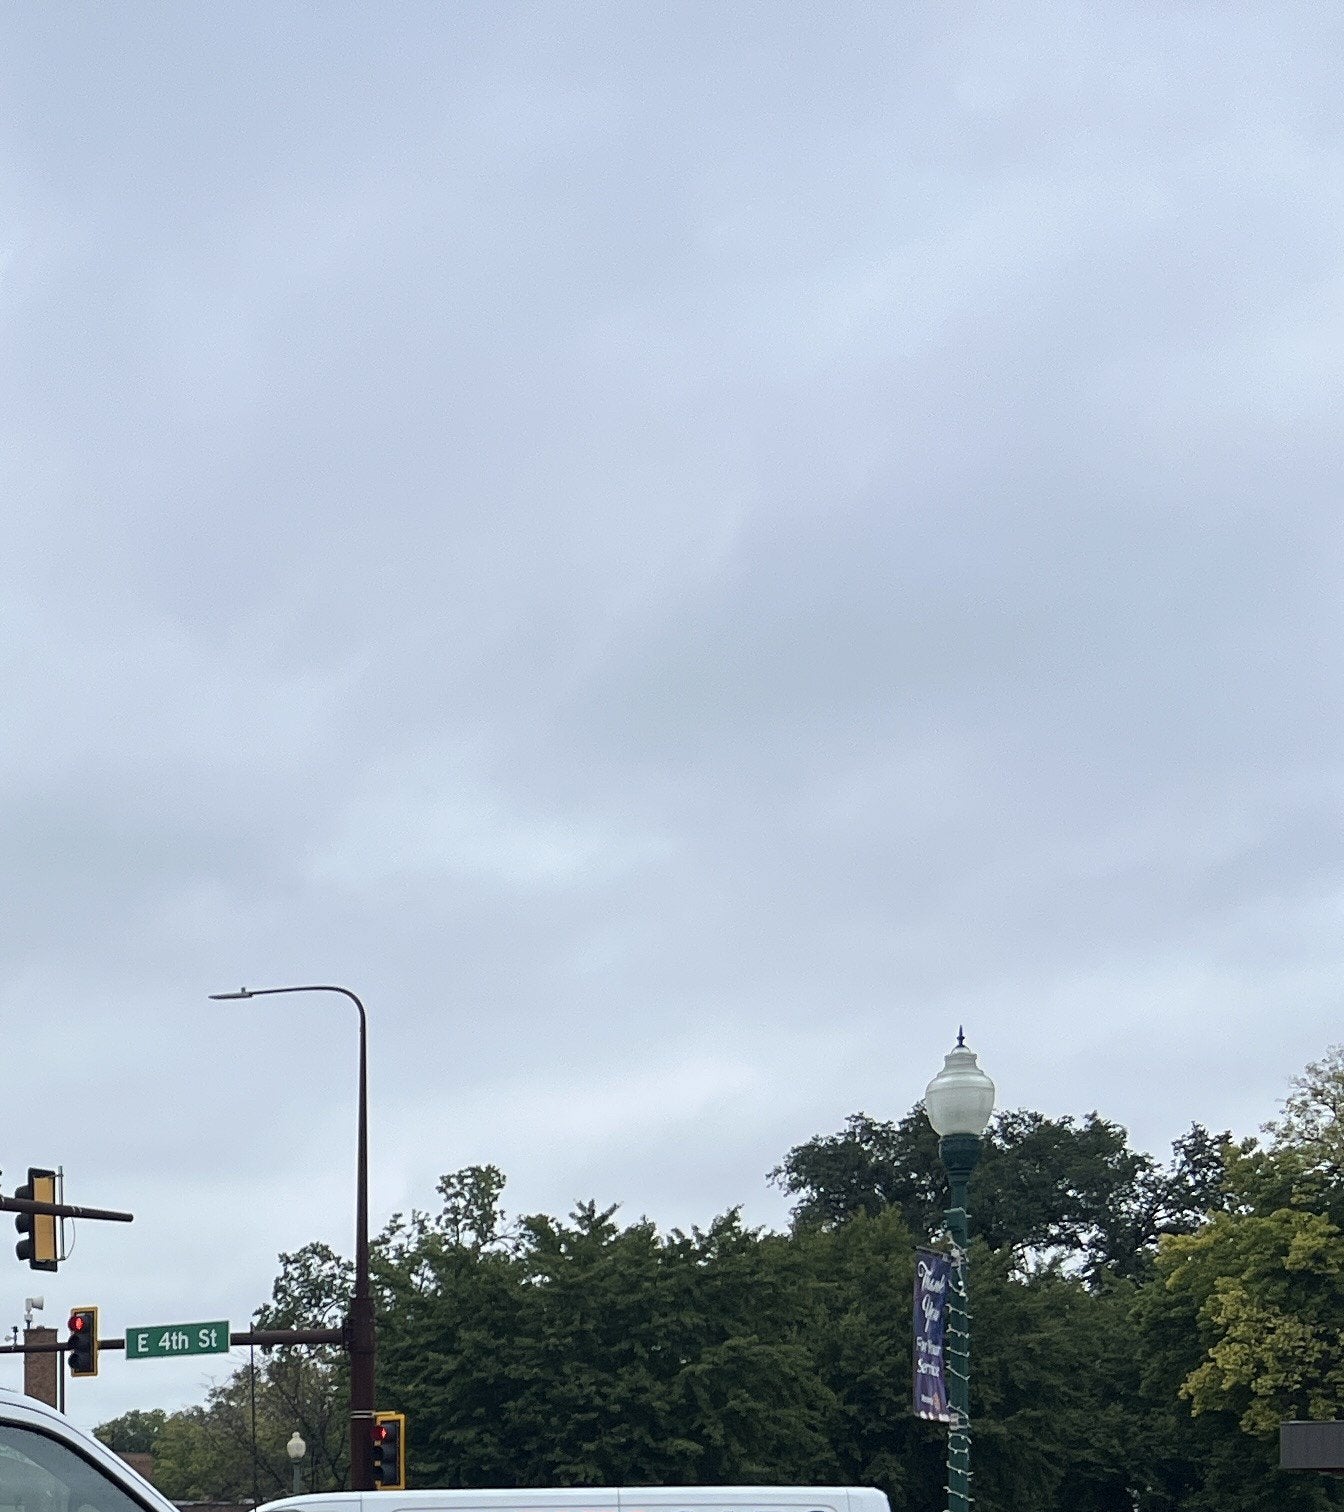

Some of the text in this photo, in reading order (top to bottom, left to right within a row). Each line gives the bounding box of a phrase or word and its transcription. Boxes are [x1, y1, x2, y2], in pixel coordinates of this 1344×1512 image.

[137, 1328, 217, 1352] E 4th St
